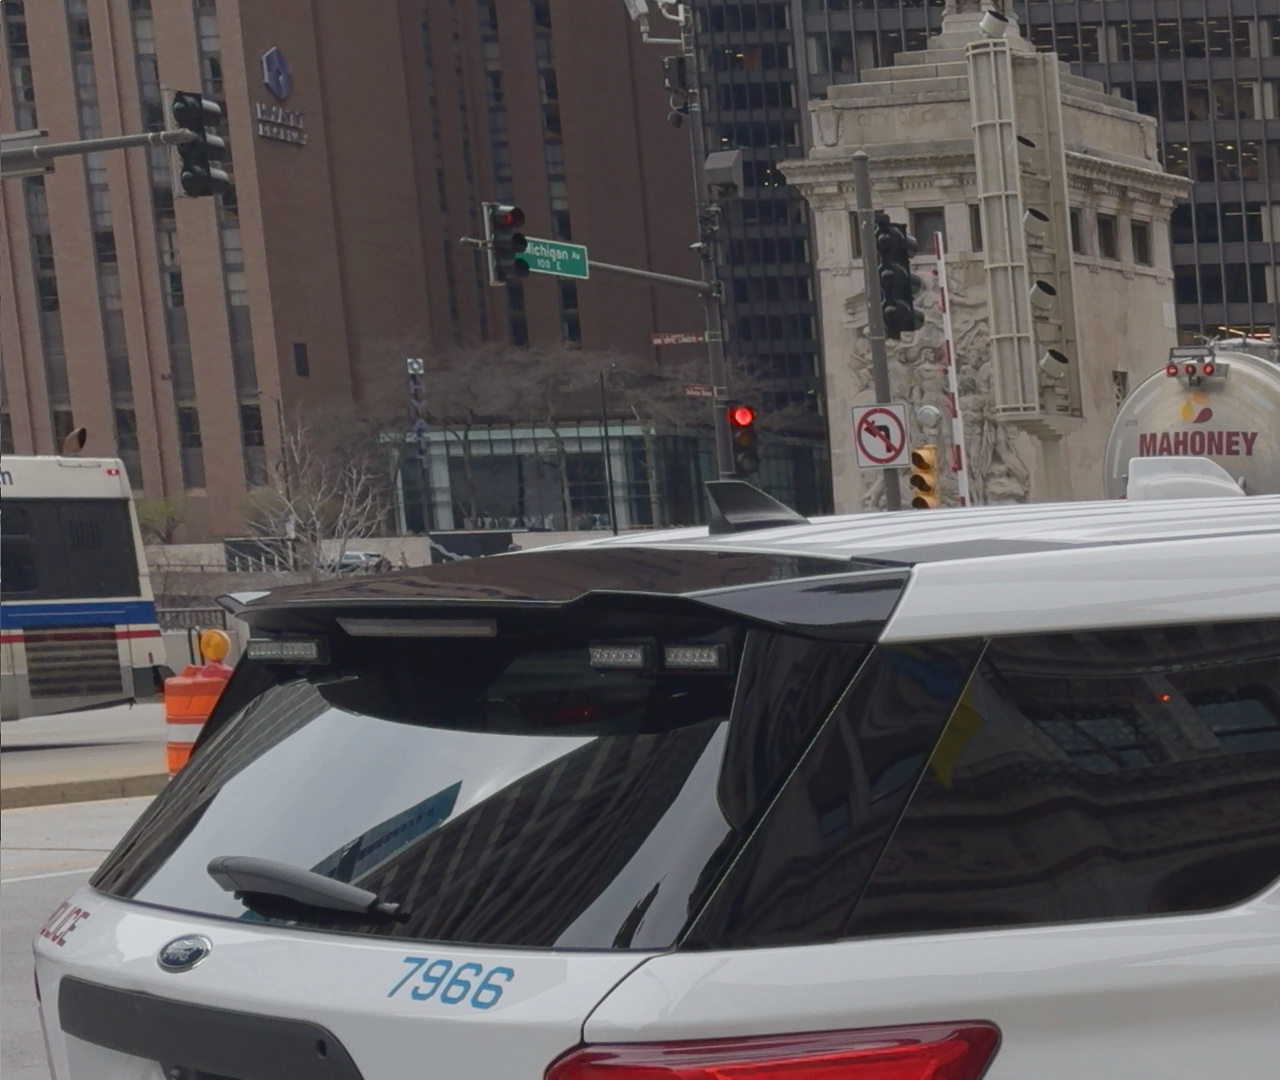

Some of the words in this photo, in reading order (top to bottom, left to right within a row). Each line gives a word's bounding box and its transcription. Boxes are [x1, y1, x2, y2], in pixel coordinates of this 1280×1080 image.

[537, 259, 551, 269] 100
[1139, 431, 1258, 457] MAHONEY
[387, 956, 515, 1009] 7966
